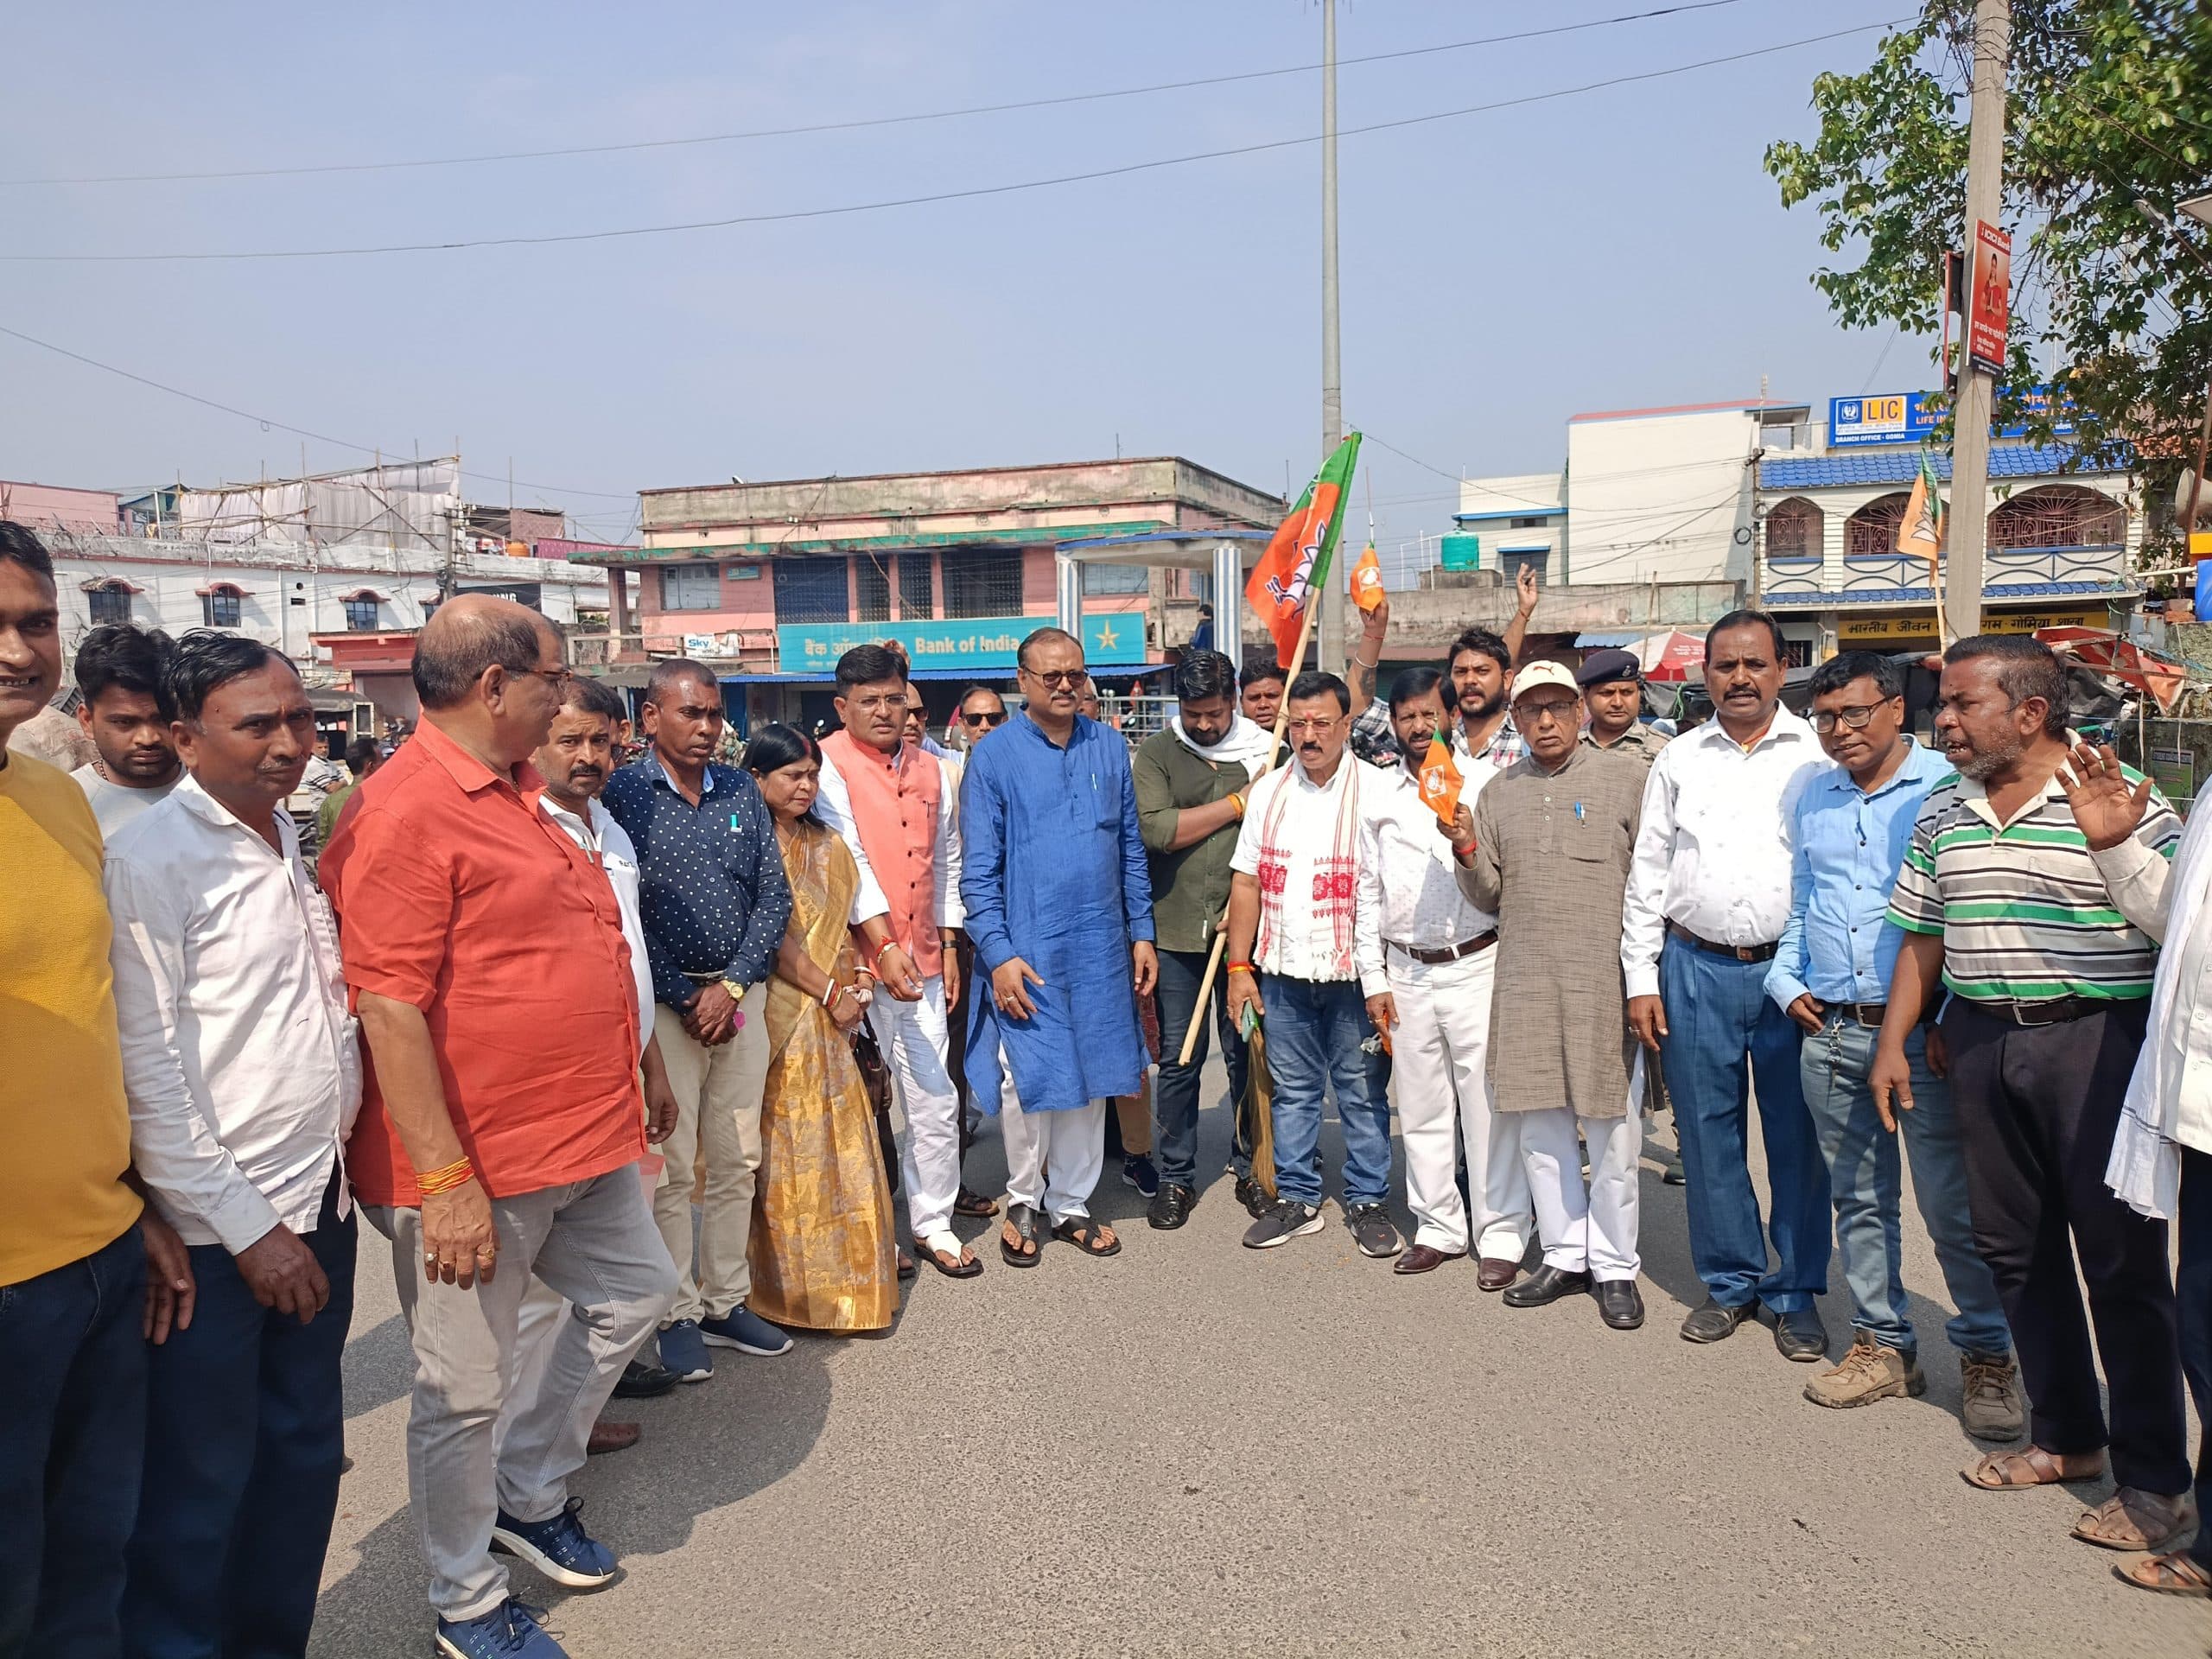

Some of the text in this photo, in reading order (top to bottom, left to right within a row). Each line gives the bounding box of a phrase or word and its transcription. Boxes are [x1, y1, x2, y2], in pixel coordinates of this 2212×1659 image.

[1867, 401, 1898, 420] LIC
[1916, 416, 1935, 424] LIFE
[1896, 620, 1931, 632] जीवन
[1980, 620, 2003, 629] गम
[688, 639, 709, 648] Sky
[915, 634, 1020, 654] Bank of India
